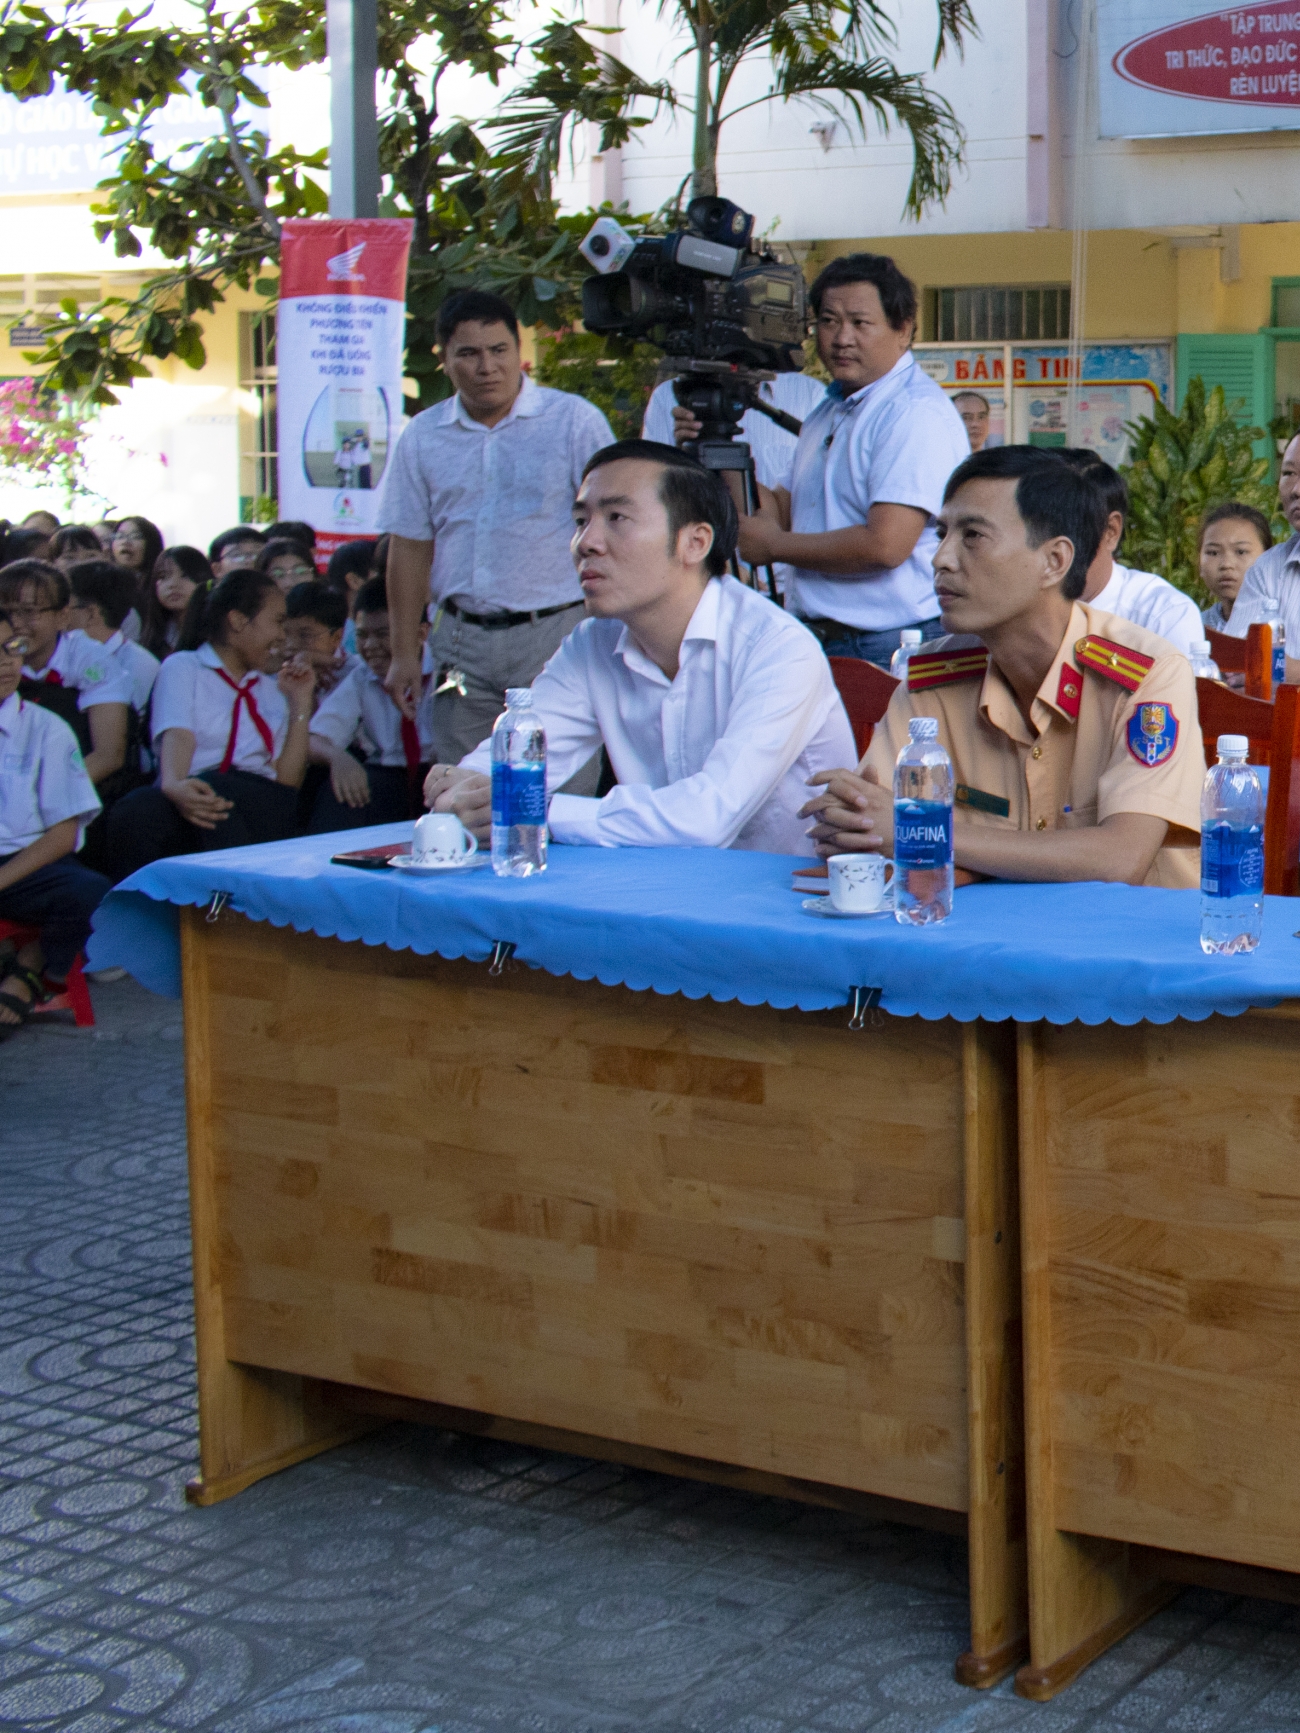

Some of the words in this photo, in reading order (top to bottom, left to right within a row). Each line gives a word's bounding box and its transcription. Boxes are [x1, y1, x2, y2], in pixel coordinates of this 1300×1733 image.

[1165, 51, 1184, 69] TRI
[1187, 43, 1228, 68] THỨC,
[1231, 45, 1262, 67] ĐẠO
[1265, 38, 1297, 63] ĐỨC
[1230, 72, 1259, 95] RÈN
[16, 95, 73, 133] GIÁO
[27, 143, 80, 181] HỌC
